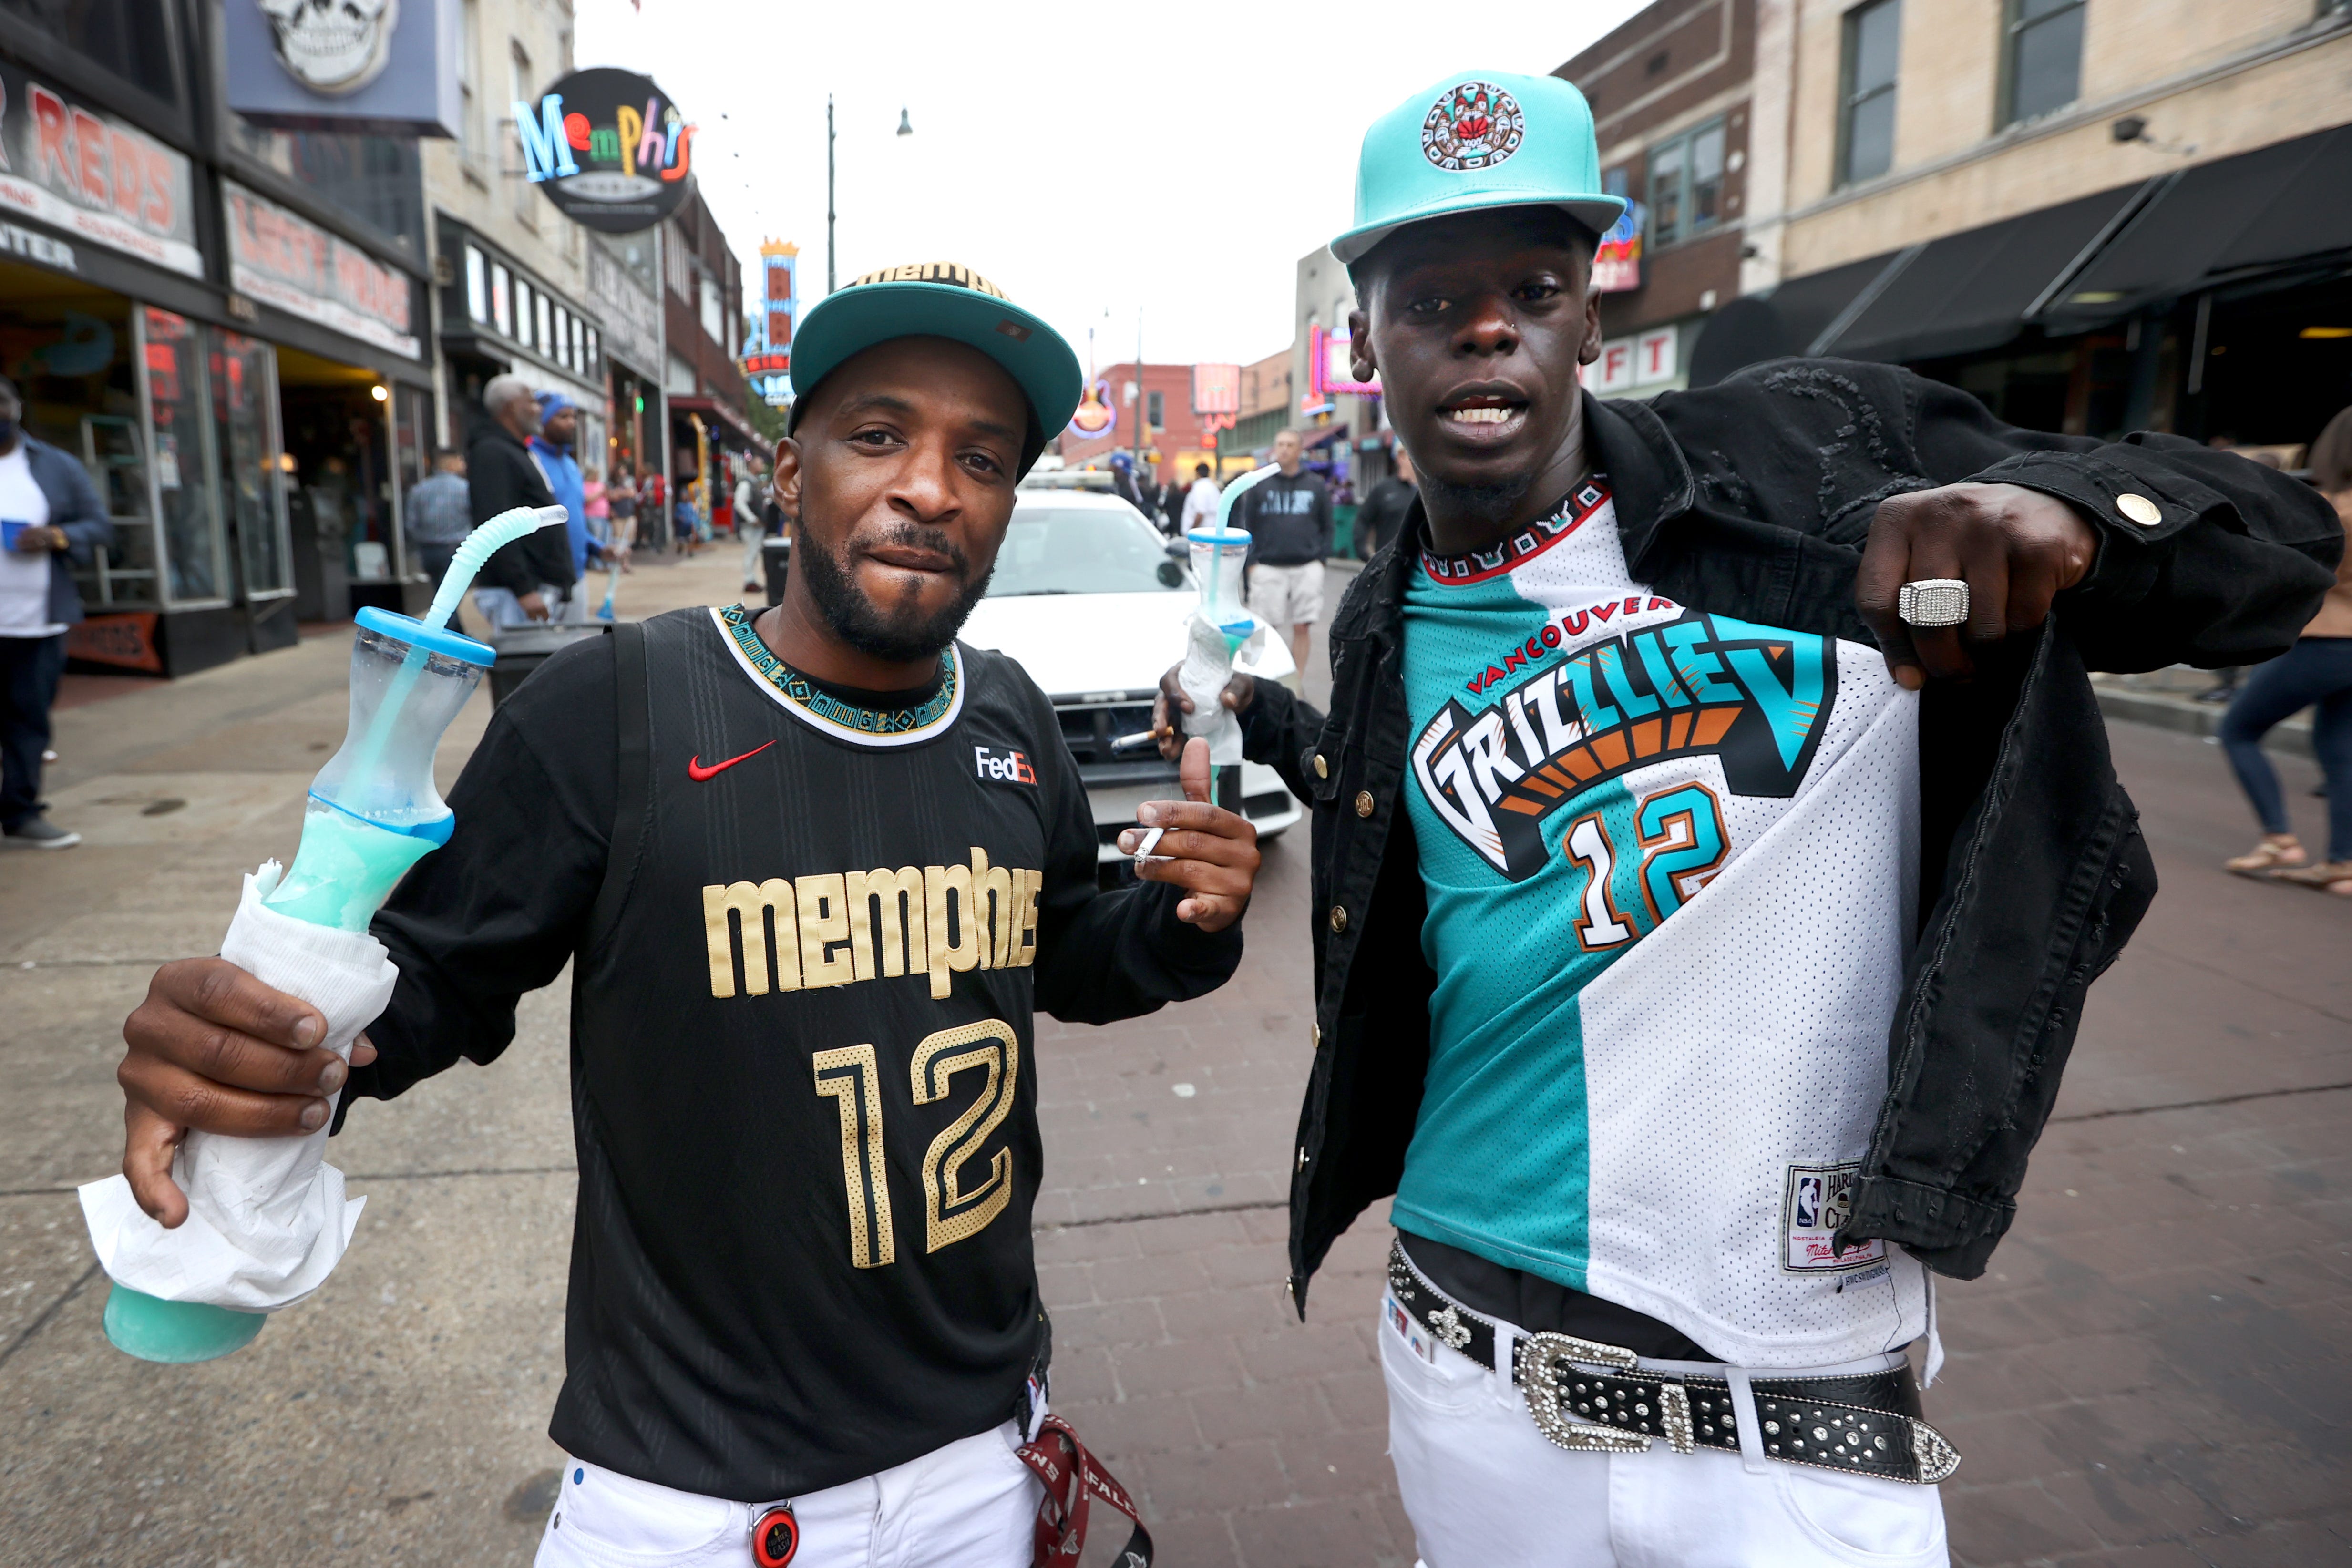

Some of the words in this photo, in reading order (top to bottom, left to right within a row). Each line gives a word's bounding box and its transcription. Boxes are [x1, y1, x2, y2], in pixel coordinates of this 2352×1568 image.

[510, 93, 699, 183] Memphis
[1465, 596, 1676, 696] VANCOUVER
[974, 746, 1038, 787] FedEx
[702, 846, 1044, 1000] memphis
[1561, 781, 1732, 953] 12
[812, 1018, 1018, 1269] 12
